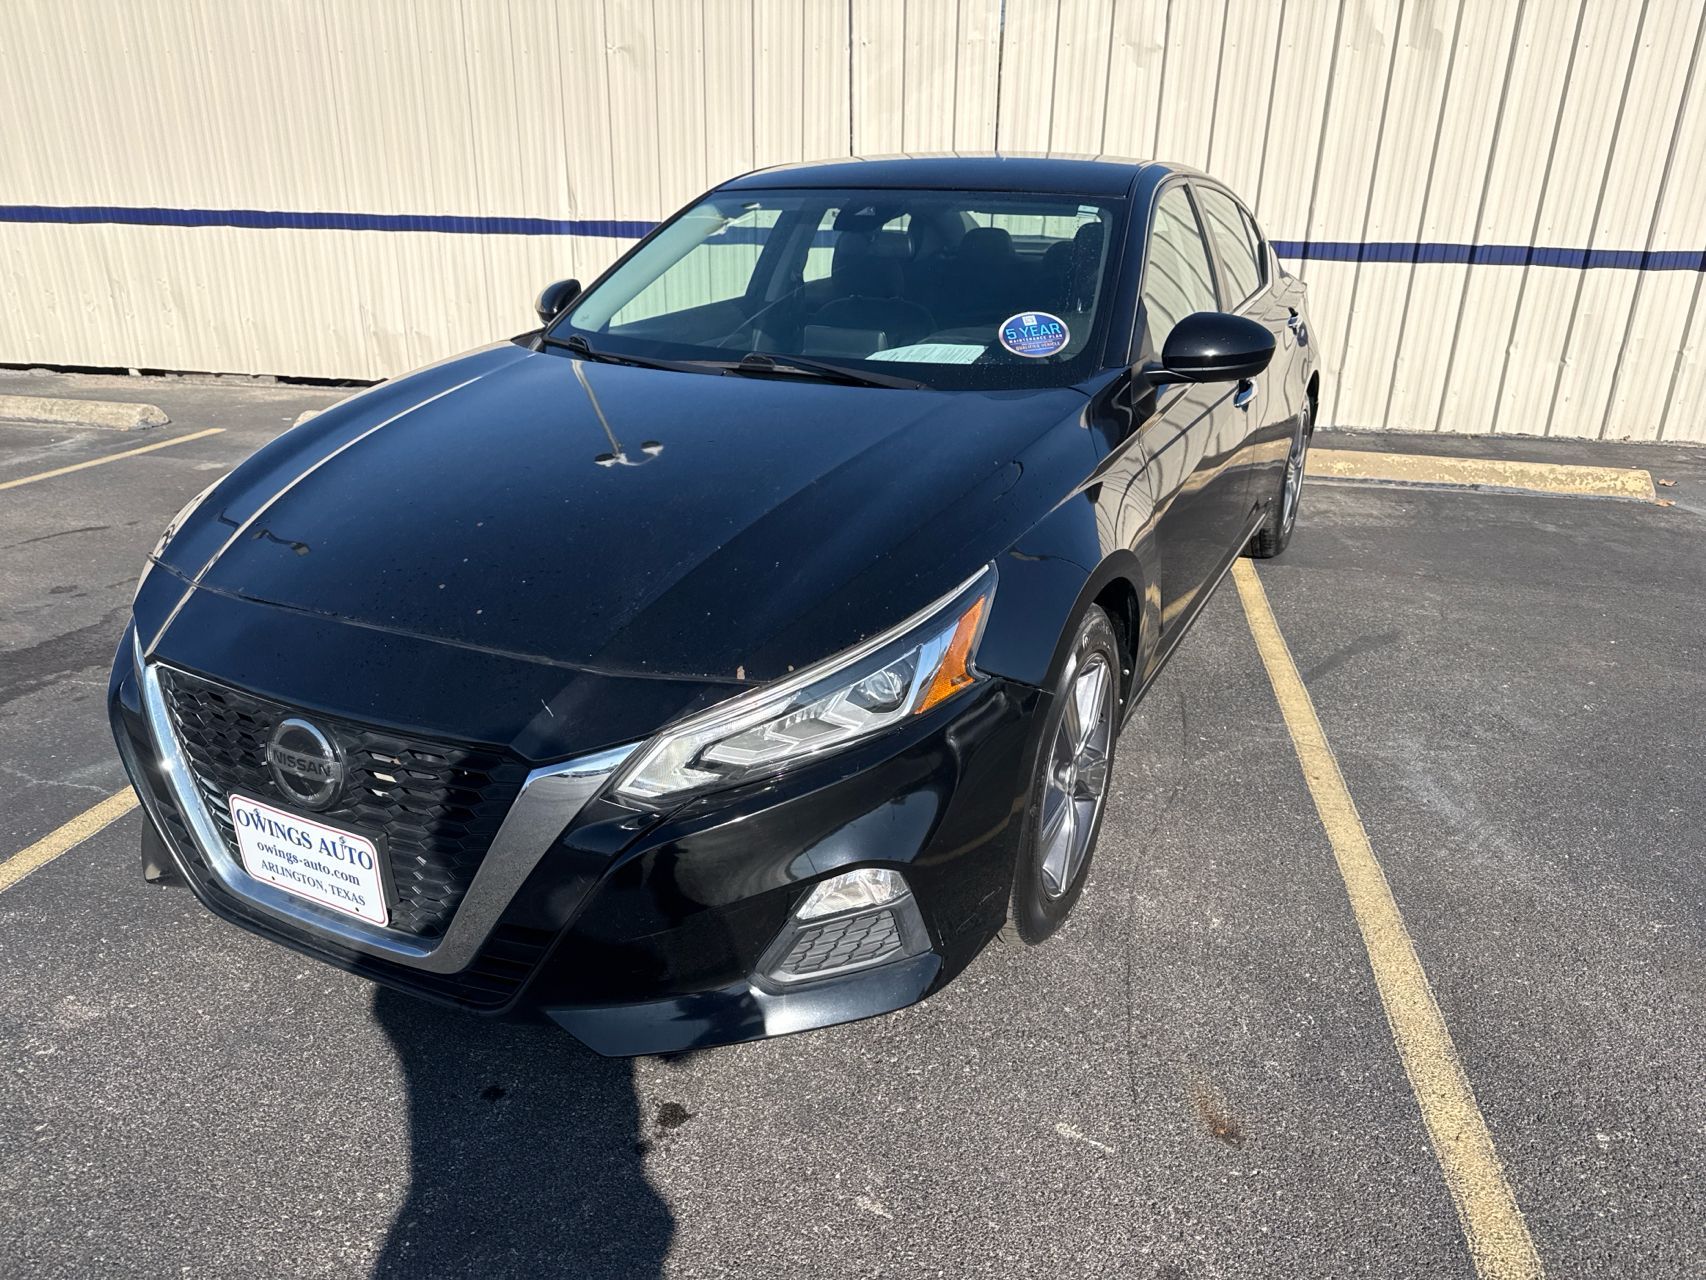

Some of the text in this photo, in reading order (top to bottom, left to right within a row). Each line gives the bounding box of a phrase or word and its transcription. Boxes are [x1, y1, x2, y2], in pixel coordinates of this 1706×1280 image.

[1005, 322, 1061, 340] 5 YEAR
[273, 749, 331, 777] NISSAN
[236, 808, 373, 871] OWINGS AUTO
[257, 841, 360, 886] owings-auto.com
[261, 859, 366, 906] ARLINGTON, TEXAS
